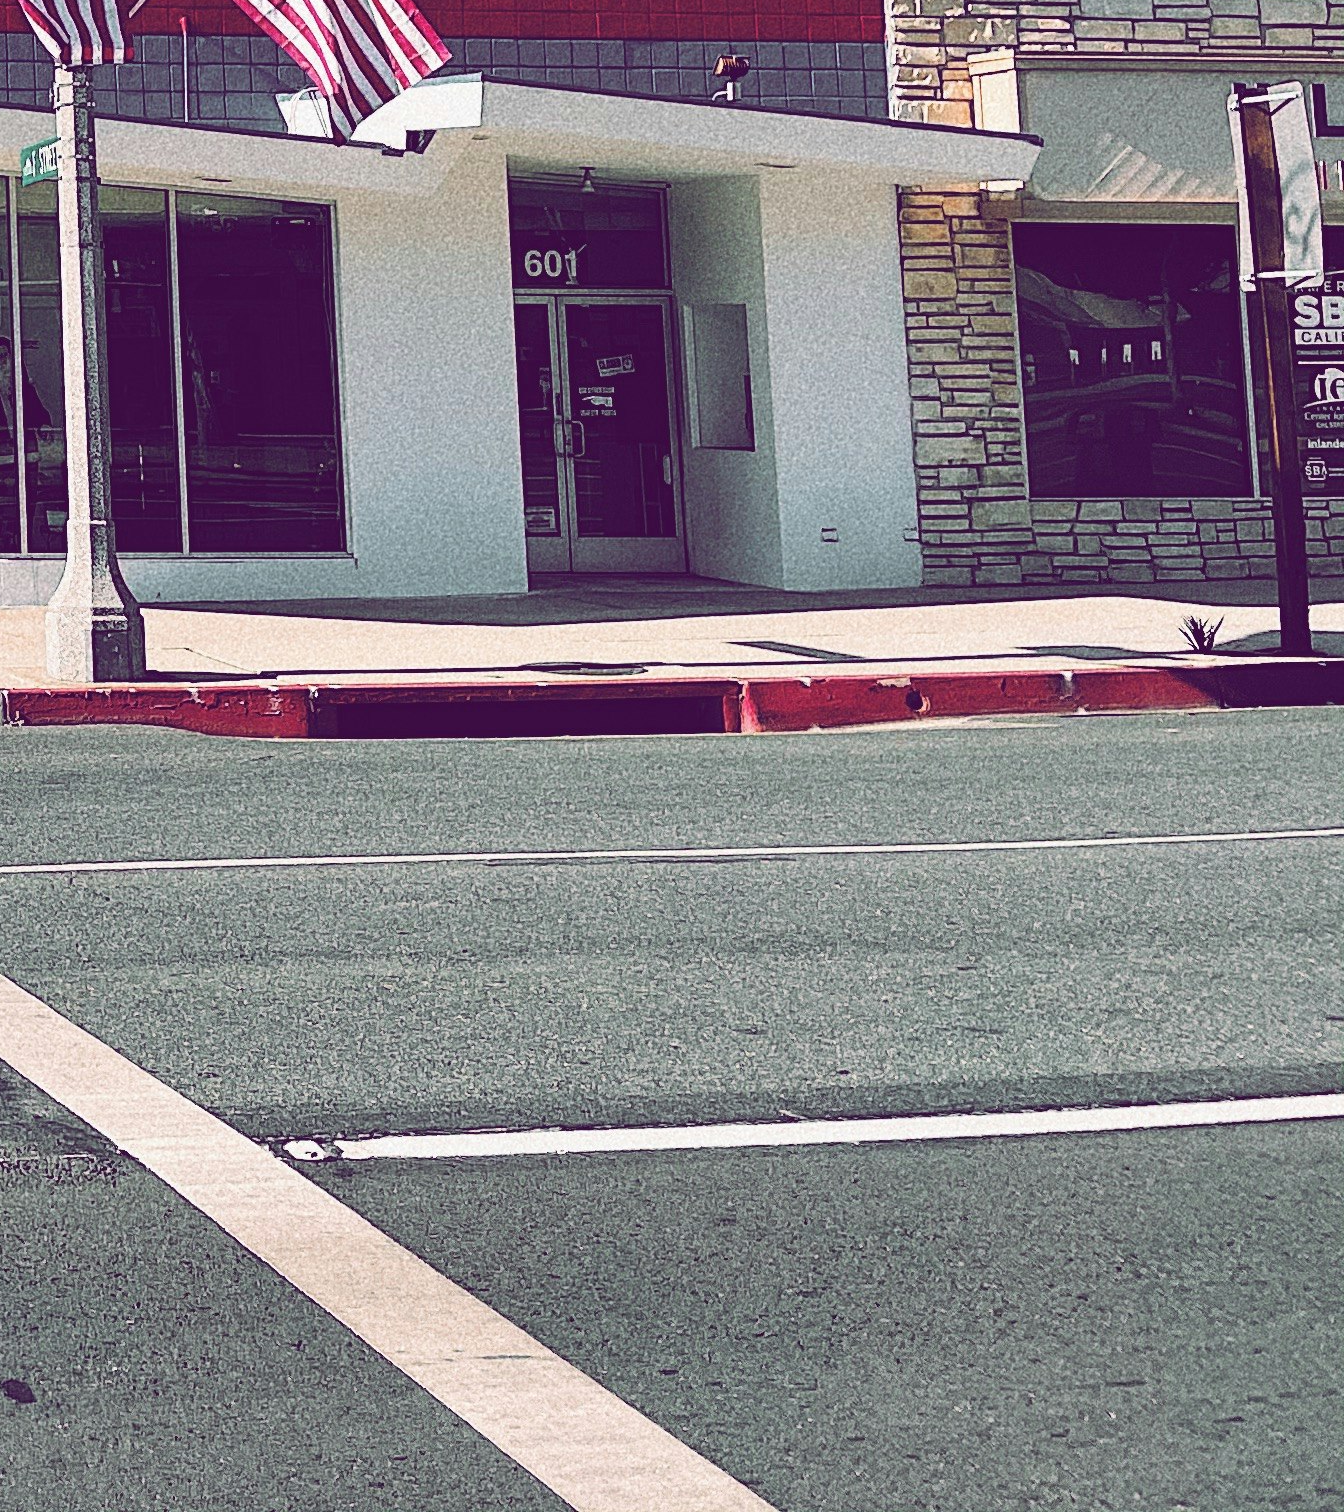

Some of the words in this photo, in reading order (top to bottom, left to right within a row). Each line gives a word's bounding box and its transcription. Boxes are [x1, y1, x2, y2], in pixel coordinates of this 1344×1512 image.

[524, 250, 577, 277] 601
[1294, 295, 1344, 327] SB
[1305, 466, 1327, 475] SBA
